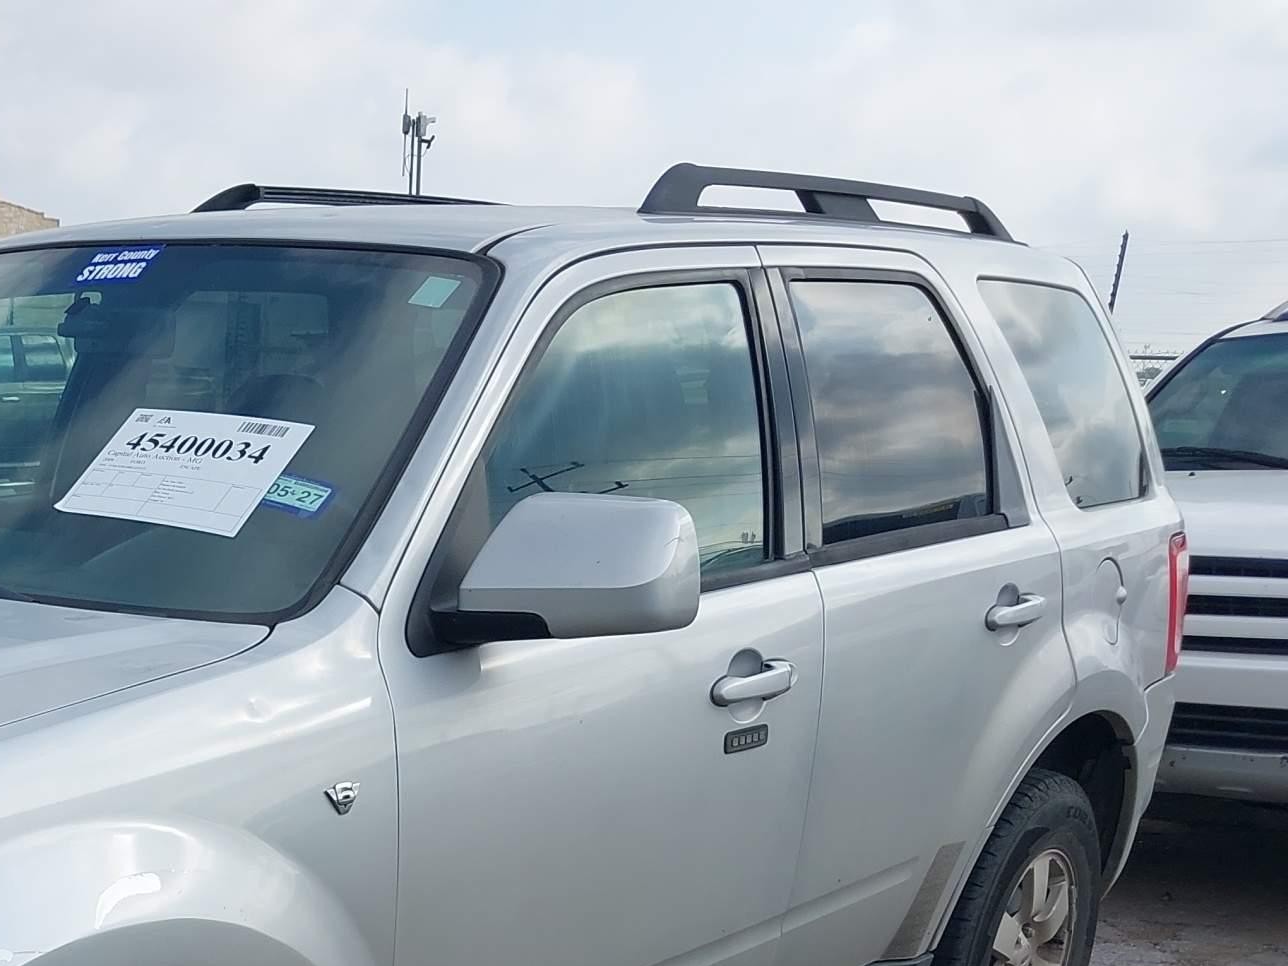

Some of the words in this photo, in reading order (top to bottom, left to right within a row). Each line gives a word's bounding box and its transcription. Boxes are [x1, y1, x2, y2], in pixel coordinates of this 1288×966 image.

[76, 262, 147, 281] STRONG
[126, 432, 272, 464] 45400034
[268, 483, 291, 497] 05
[296, 490, 324, 505] 27
